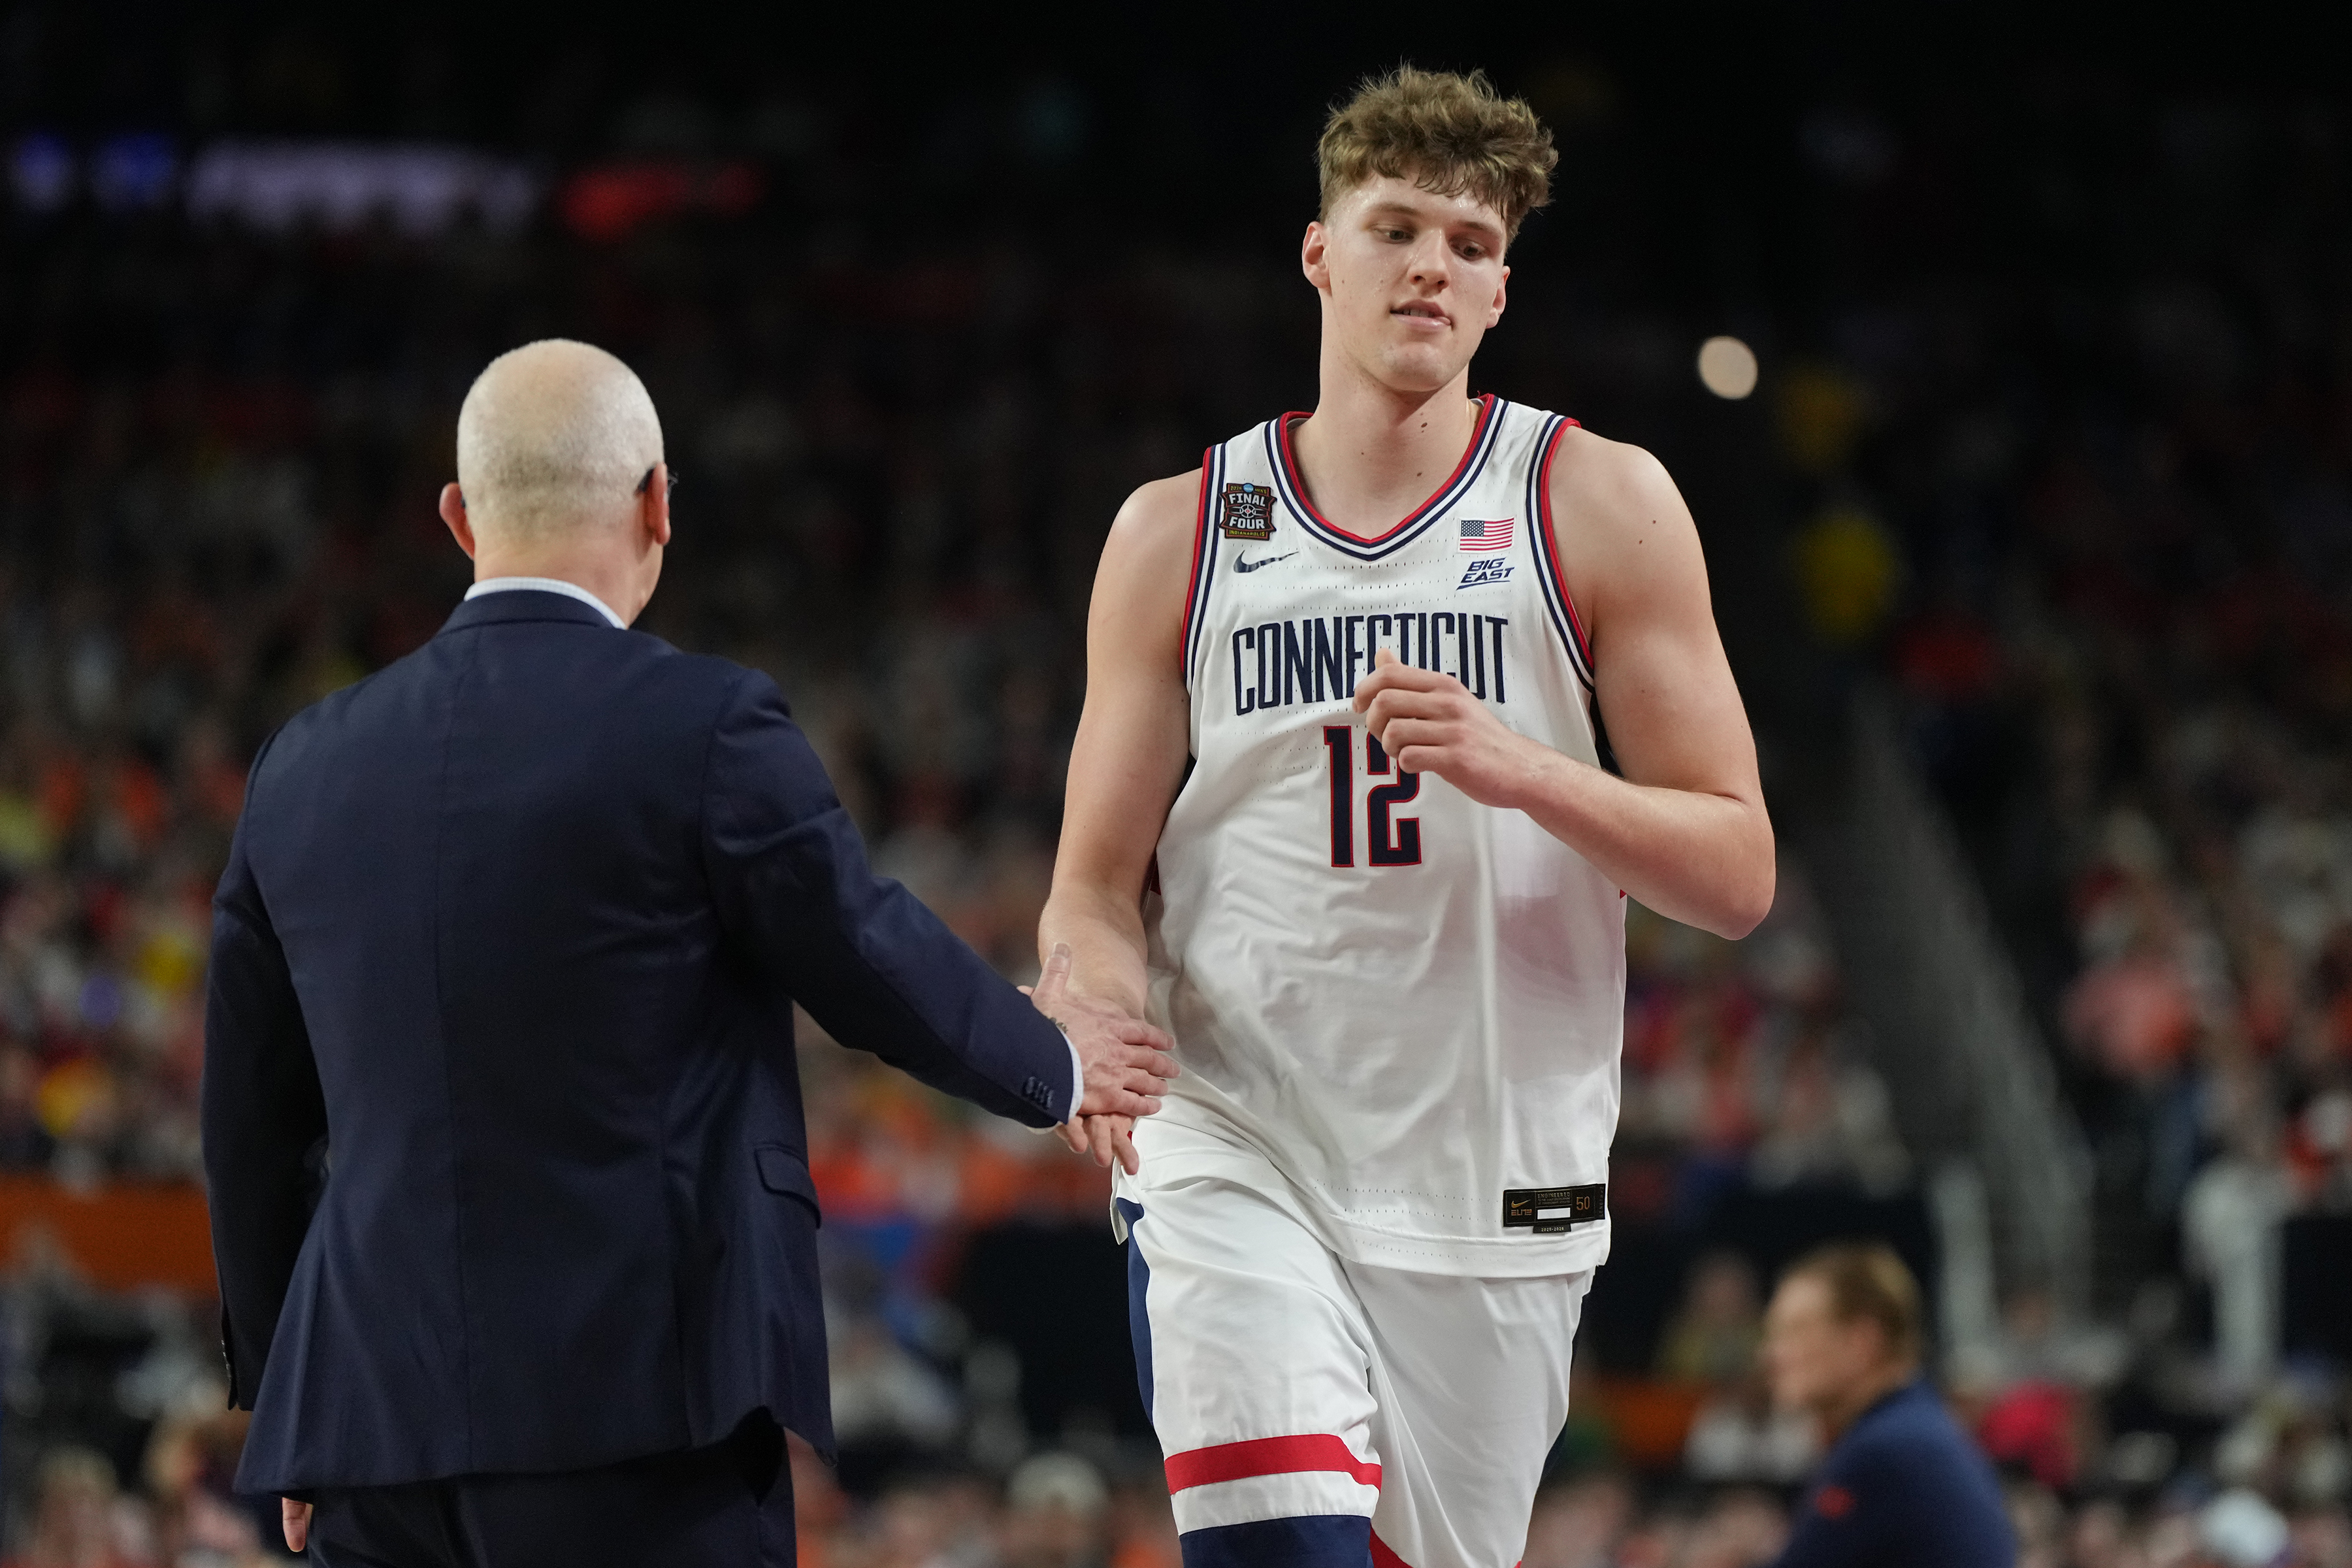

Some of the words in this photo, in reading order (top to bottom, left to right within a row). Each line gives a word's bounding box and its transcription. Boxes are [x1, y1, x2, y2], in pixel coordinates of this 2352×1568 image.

[1229, 493, 1266, 506] FINAL
[1229, 517, 1265, 529] FOUR
[1467, 557, 1507, 572] BIG
[1460, 566, 1515, 583] EAST
[1232, 612, 1508, 716] CONNECTICUT
[1323, 725, 1422, 868] 12
[1576, 1196, 1590, 1211] 50
